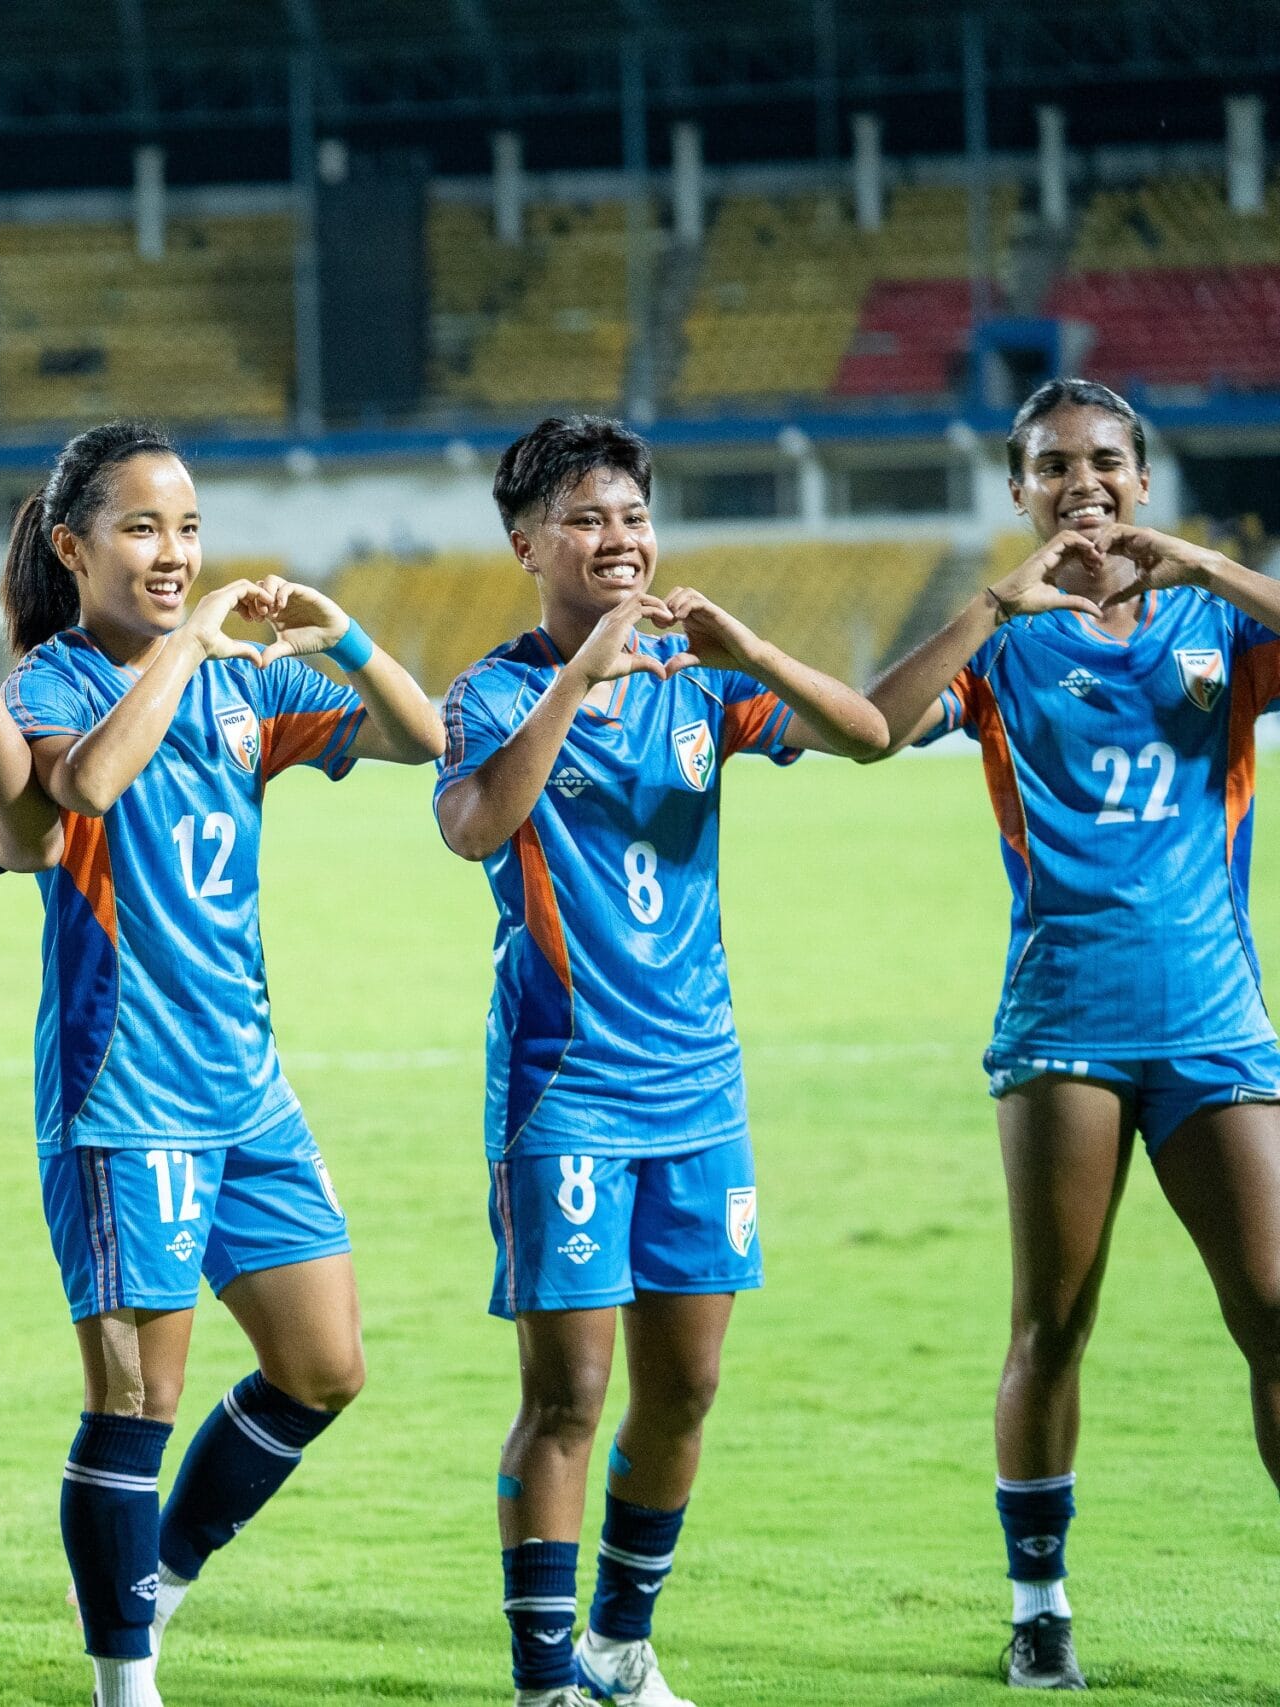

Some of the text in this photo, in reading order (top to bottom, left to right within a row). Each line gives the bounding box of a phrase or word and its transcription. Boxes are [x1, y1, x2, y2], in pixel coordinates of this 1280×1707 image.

[1058, 678, 1102, 688] NIVIA
[223, 714, 246, 726] INDIA
[548, 779, 594, 787] NIVIA
[1092, 741, 1180, 826] 22
[172, 811, 237, 900] 12
[623, 841, 664, 925] 8
[146, 1150, 201, 1224] 12
[558, 1155, 597, 1225] 8
[166, 1240, 197, 1252] NIVIA
[558, 1243, 601, 1254] NIVIA
